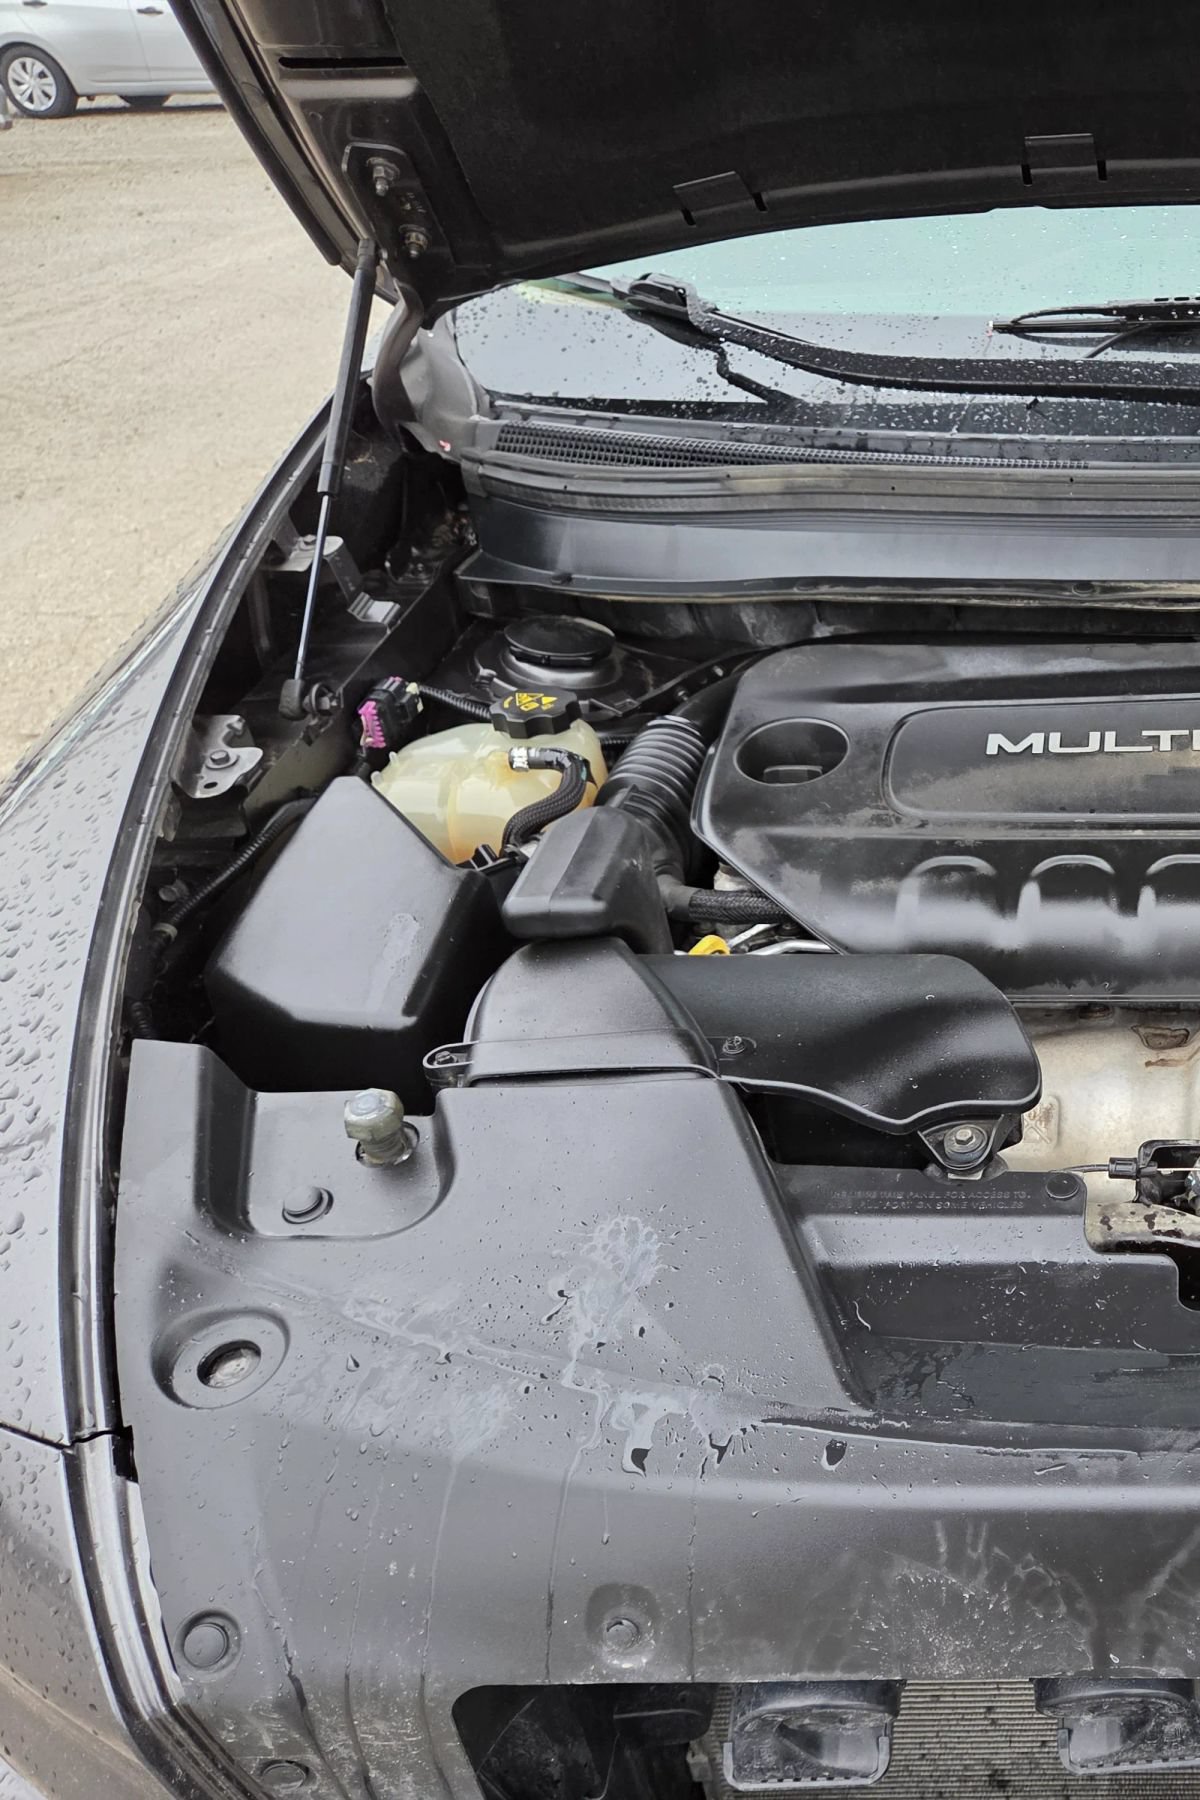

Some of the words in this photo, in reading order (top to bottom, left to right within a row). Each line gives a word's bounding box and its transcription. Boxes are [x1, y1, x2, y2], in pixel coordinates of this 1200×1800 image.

[908, 1191, 942, 1200] PANEL
[944, 1191, 967, 1200] FOR
[968, 1191, 1011, 1199] ACCESS
[936, 1201, 968, 1210] SOME
[972, 1200, 1024, 1210] VEHICLES
